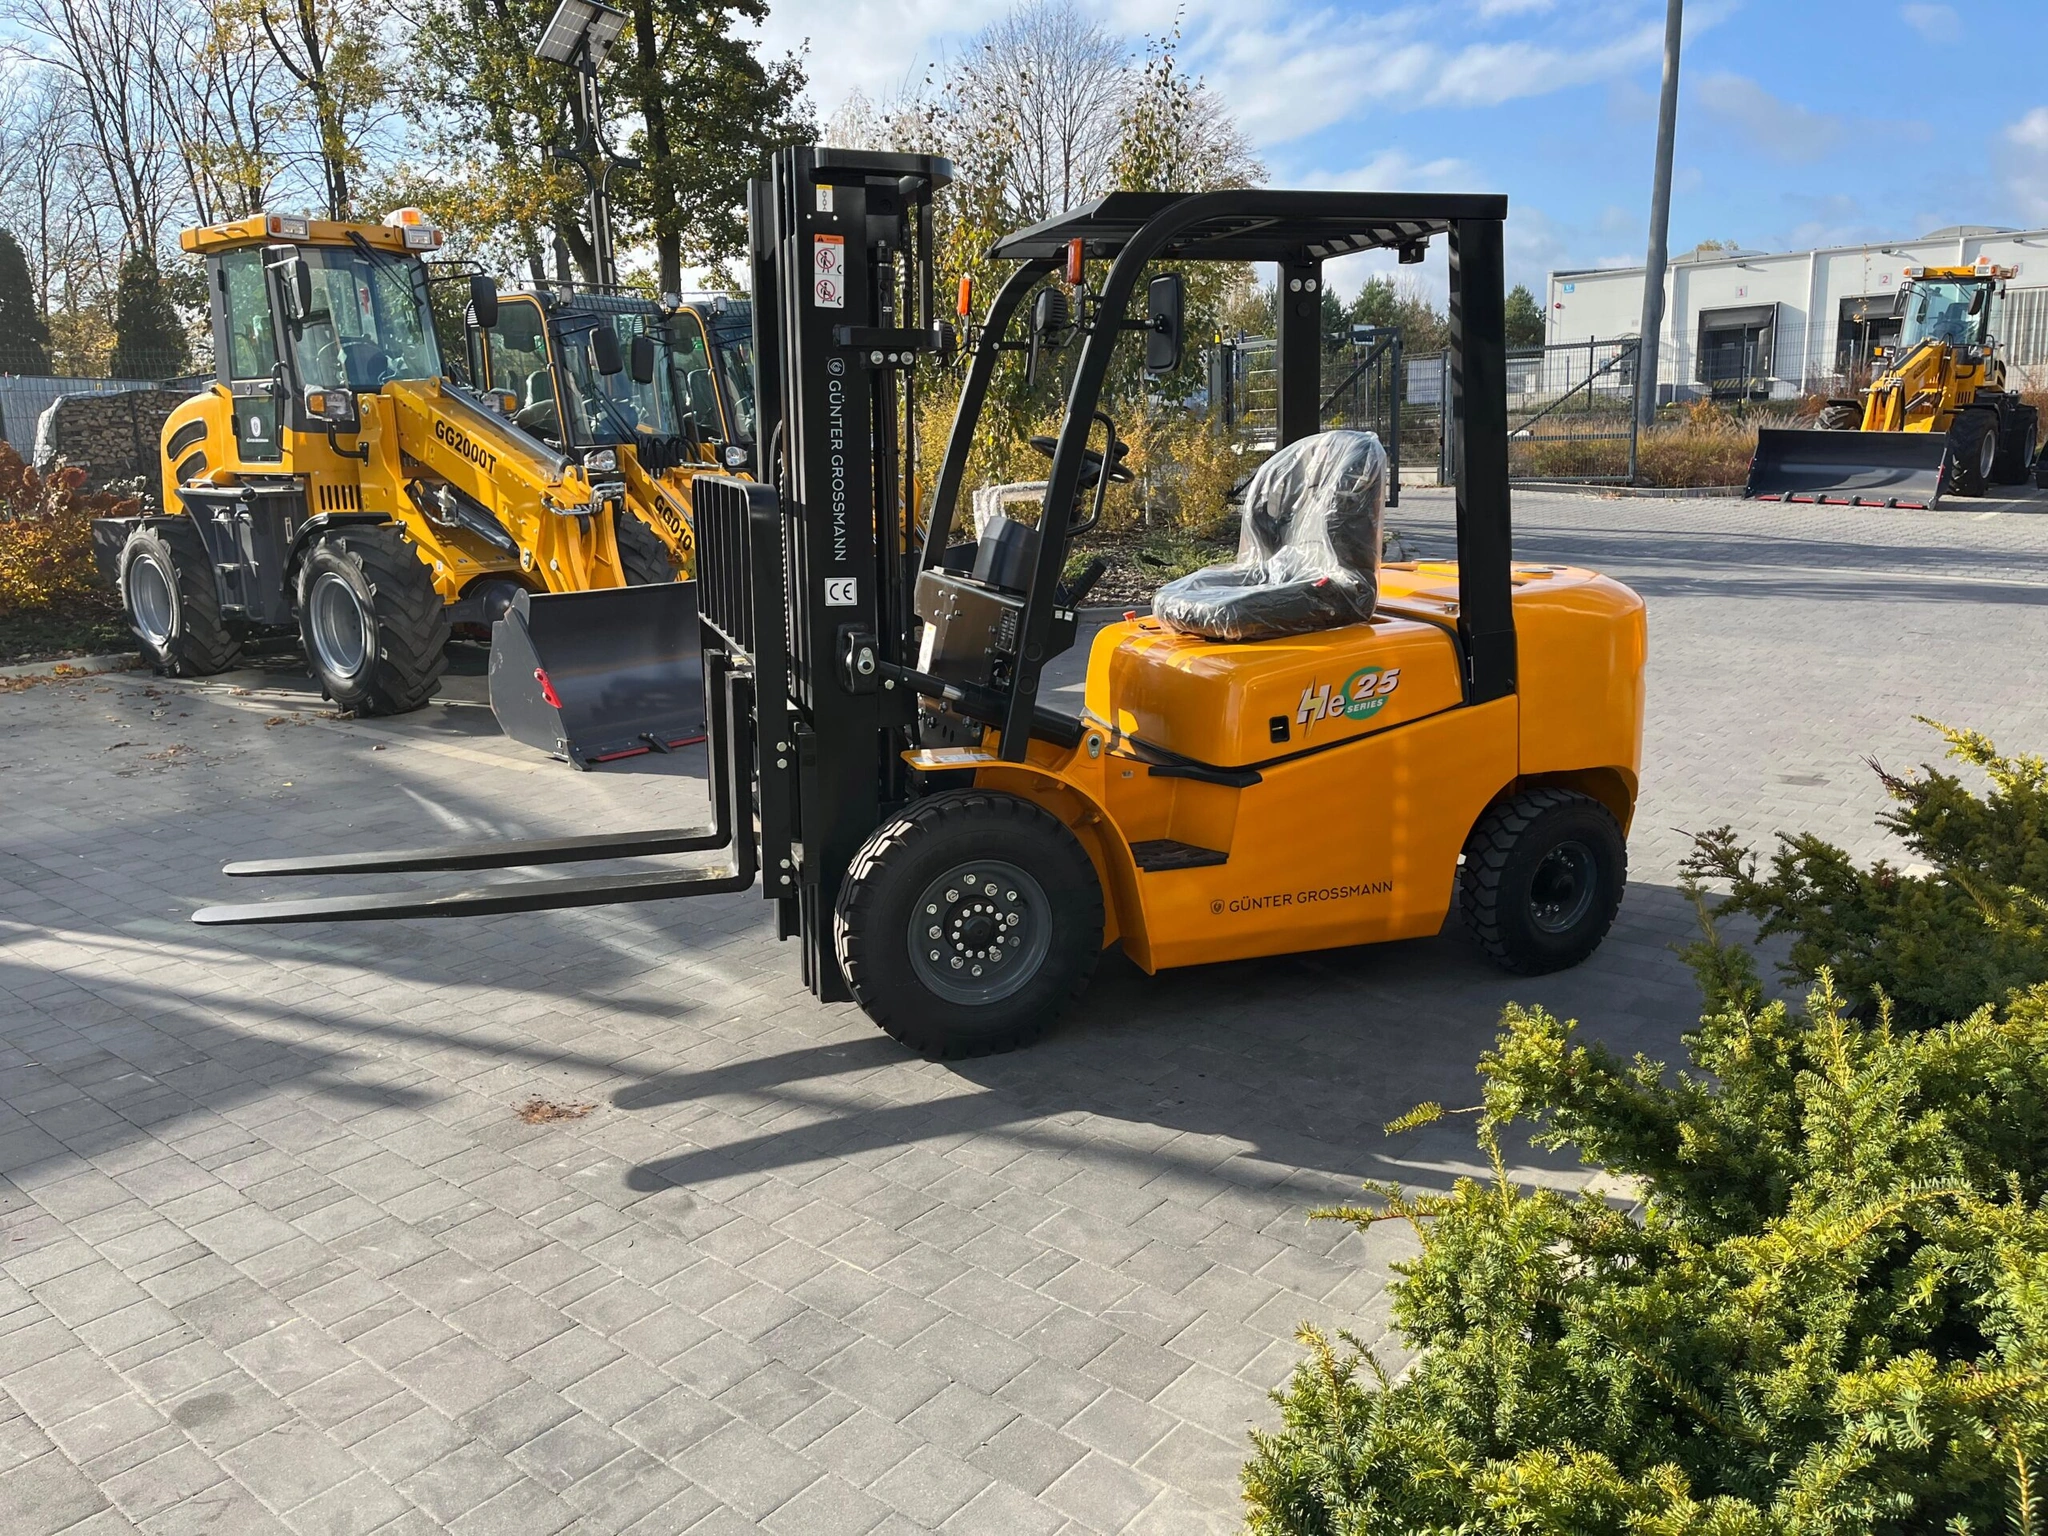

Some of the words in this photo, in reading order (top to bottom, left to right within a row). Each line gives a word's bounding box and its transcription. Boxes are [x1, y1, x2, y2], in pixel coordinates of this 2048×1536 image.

[828, 380, 845, 451] GÜNTER
[435, 419, 497, 474] GG2000T
[830, 454, 847, 561] GROSSMANN
[829, 582, 853, 601] CE
[1353, 667, 1401, 701] 25
[1346, 698, 1384, 714] SERIES
[1228, 893, 1293, 913] GÜNTER
[1296, 880, 1393, 904] GROSSMANN
